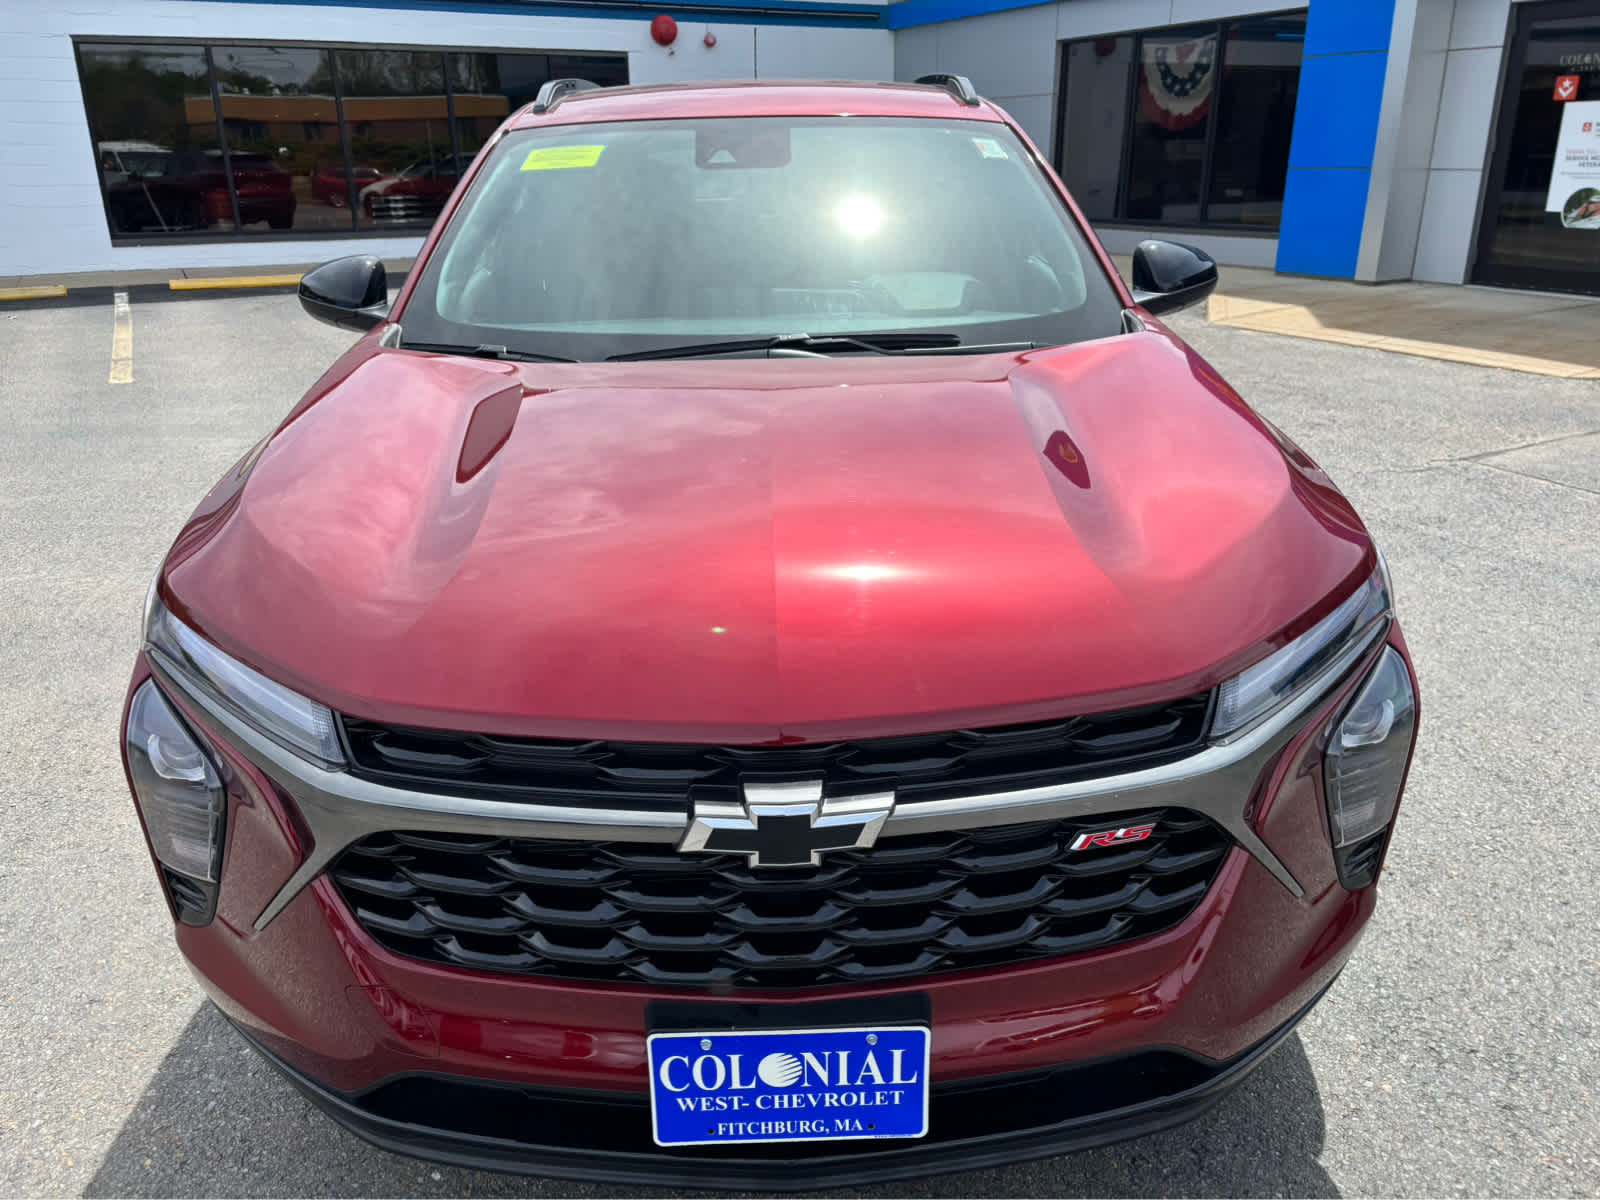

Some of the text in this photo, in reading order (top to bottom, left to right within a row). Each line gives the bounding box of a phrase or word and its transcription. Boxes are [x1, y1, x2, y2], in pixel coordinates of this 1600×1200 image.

[1070, 823, 1157, 850] RS
[659, 1049, 918, 1092] COLONIAL
[755, 1090, 905, 1110] CHEVROLET
[717, 1118, 863, 1136] FITCHBURG, MA
